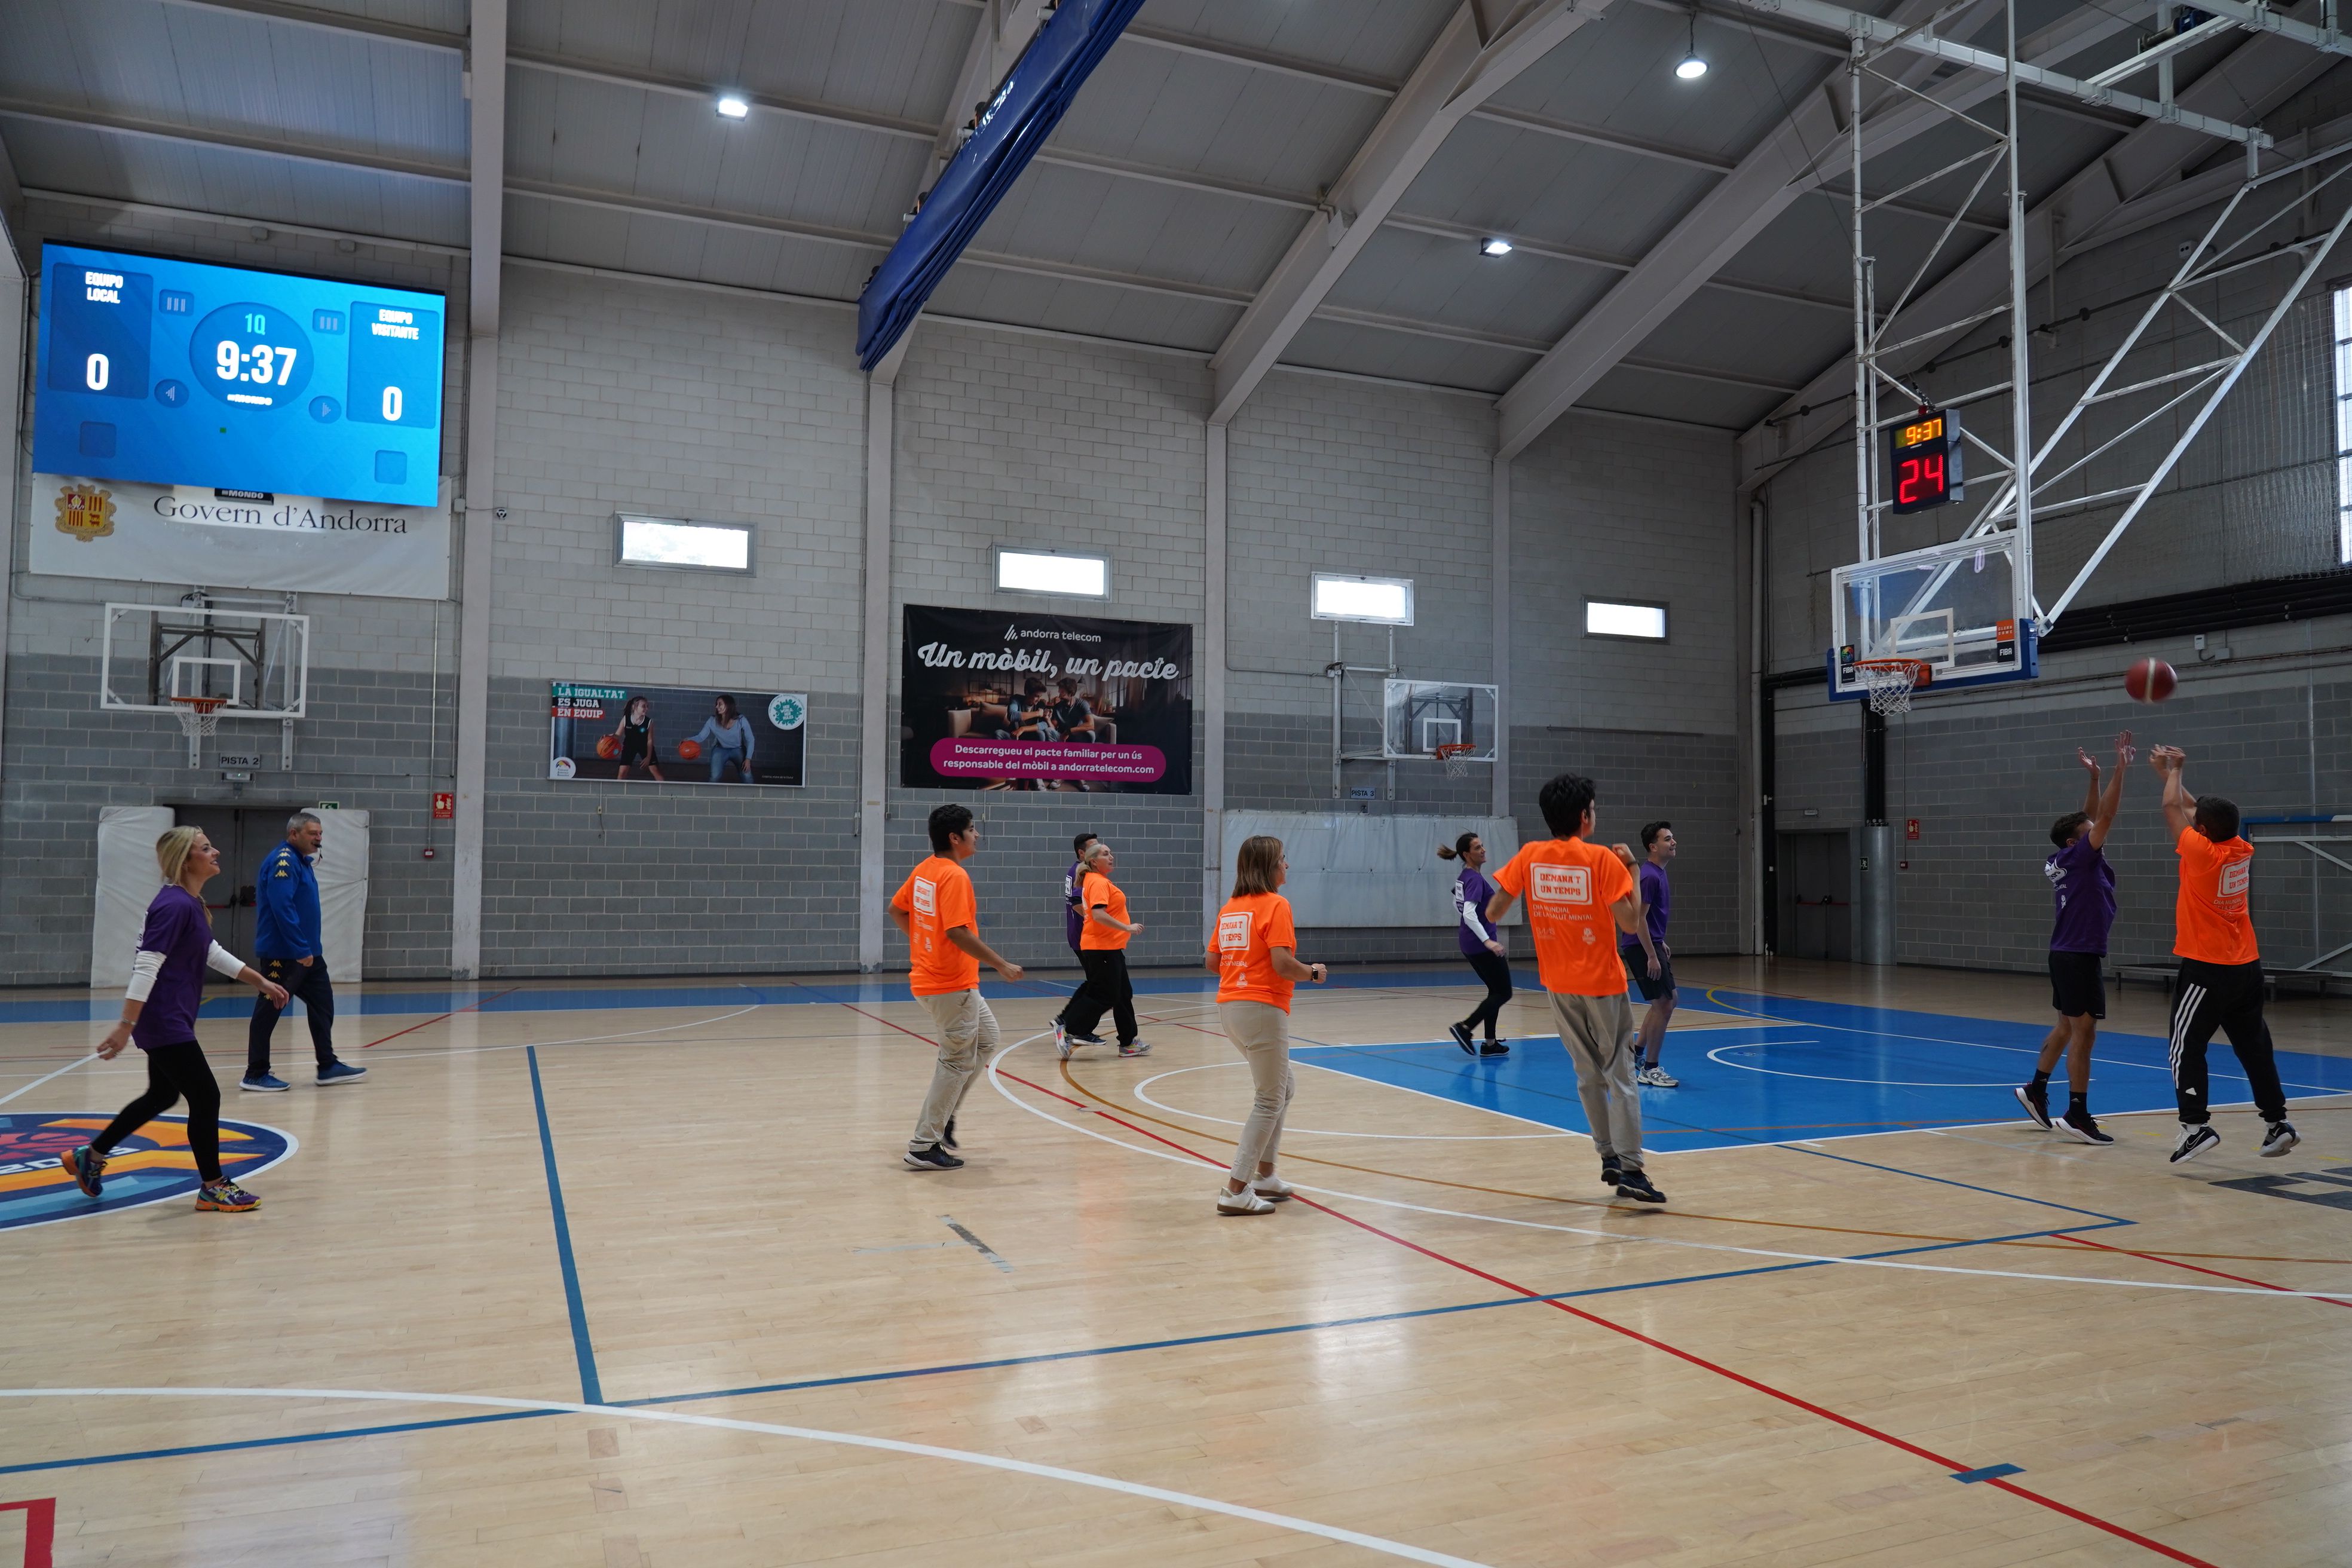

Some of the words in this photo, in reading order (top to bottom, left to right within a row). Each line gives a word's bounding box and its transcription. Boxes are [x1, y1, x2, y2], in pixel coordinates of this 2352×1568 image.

[85, 271, 123, 289] EQUIPO
[87, 287, 121, 304] LOCAL
[245, 313, 266, 335] 1Q
[216, 340, 297, 386] 9:37
[87, 353, 109, 391] 0
[382, 386, 403, 421] 0
[1906, 418, 1941, 446] 9:37
[1899, 455, 1943, 504] 24
[228, 489, 264, 500] MONDO
[154, 495, 262, 525] Govern
[273, 505, 408, 534] d'Andorra
[1020, 629, 1059, 639] andorra
[1062, 631, 1101, 642] telecom
[1999, 648, 2013, 656] FIBA
[917, 641, 966, 668] Un
[967, 647, 1058, 679] mòbil,
[1065, 657, 1102, 676] un
[1101, 657, 1180, 682] pacte
[558, 687, 571, 696] LA
[574, 688, 625, 699] IGUALTAT
[558, 697, 571, 706] ES
[572, 699, 599, 708] JUGA
[557, 708, 571, 717] EN
[574, 709, 604, 718] EQUIP
[955, 745, 1022, 757] Descarregueu
[1024, 747, 1033, 755] el
[1035, 748, 1062, 758] pacte
[1063, 748, 1100, 758] familiar
[1101, 751, 1116, 760] per
[1131, 751, 1142, 760] ús
[221, 757, 249, 765] PISTA
[944, 760, 1003, 770] responsable
[1005, 761, 1020, 770] del
[1022, 761, 1049, 770] mòbil
[1058, 762, 1154, 774] andorratelecom.com
[1554, 886, 1581, 896] TEMPS
[1544, 905, 1569, 914] MUNDIAL
